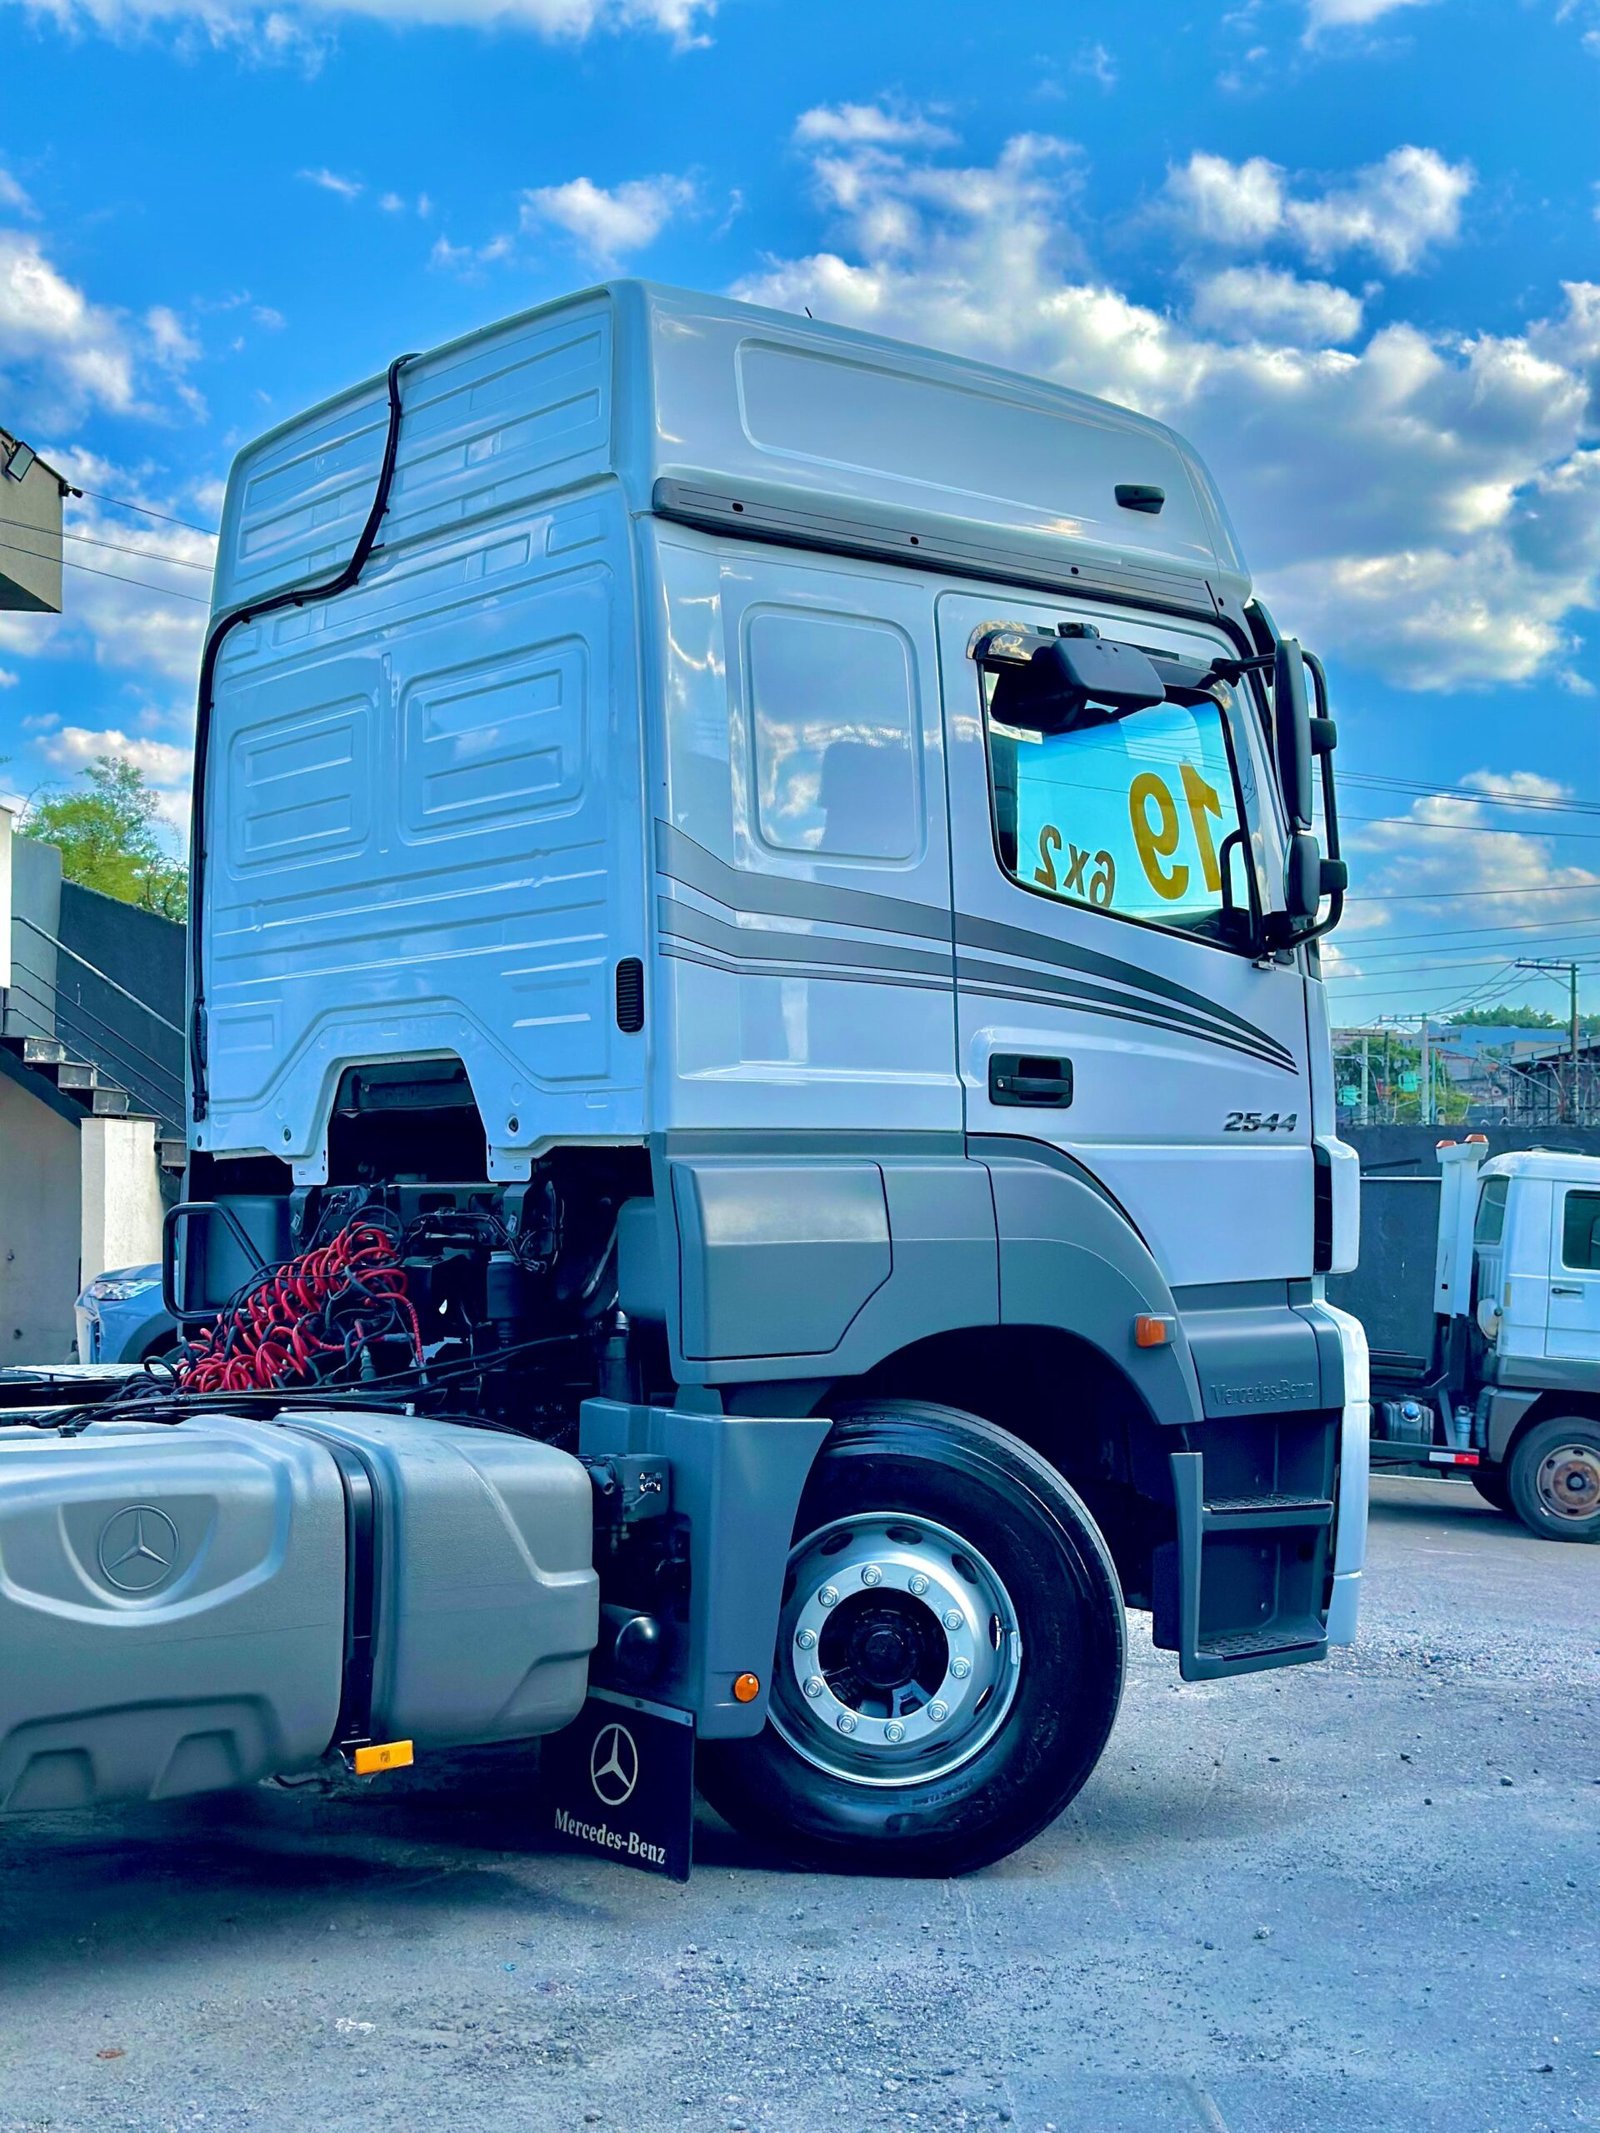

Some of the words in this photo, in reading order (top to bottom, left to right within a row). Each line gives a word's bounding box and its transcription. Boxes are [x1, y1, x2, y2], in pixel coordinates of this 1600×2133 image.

[1223, 1112, 1297, 1132] 2544
[1210, 1379, 1313, 1406] Mercedes-Benz
[554, 1808, 666, 1864] Mercedes-Benz
